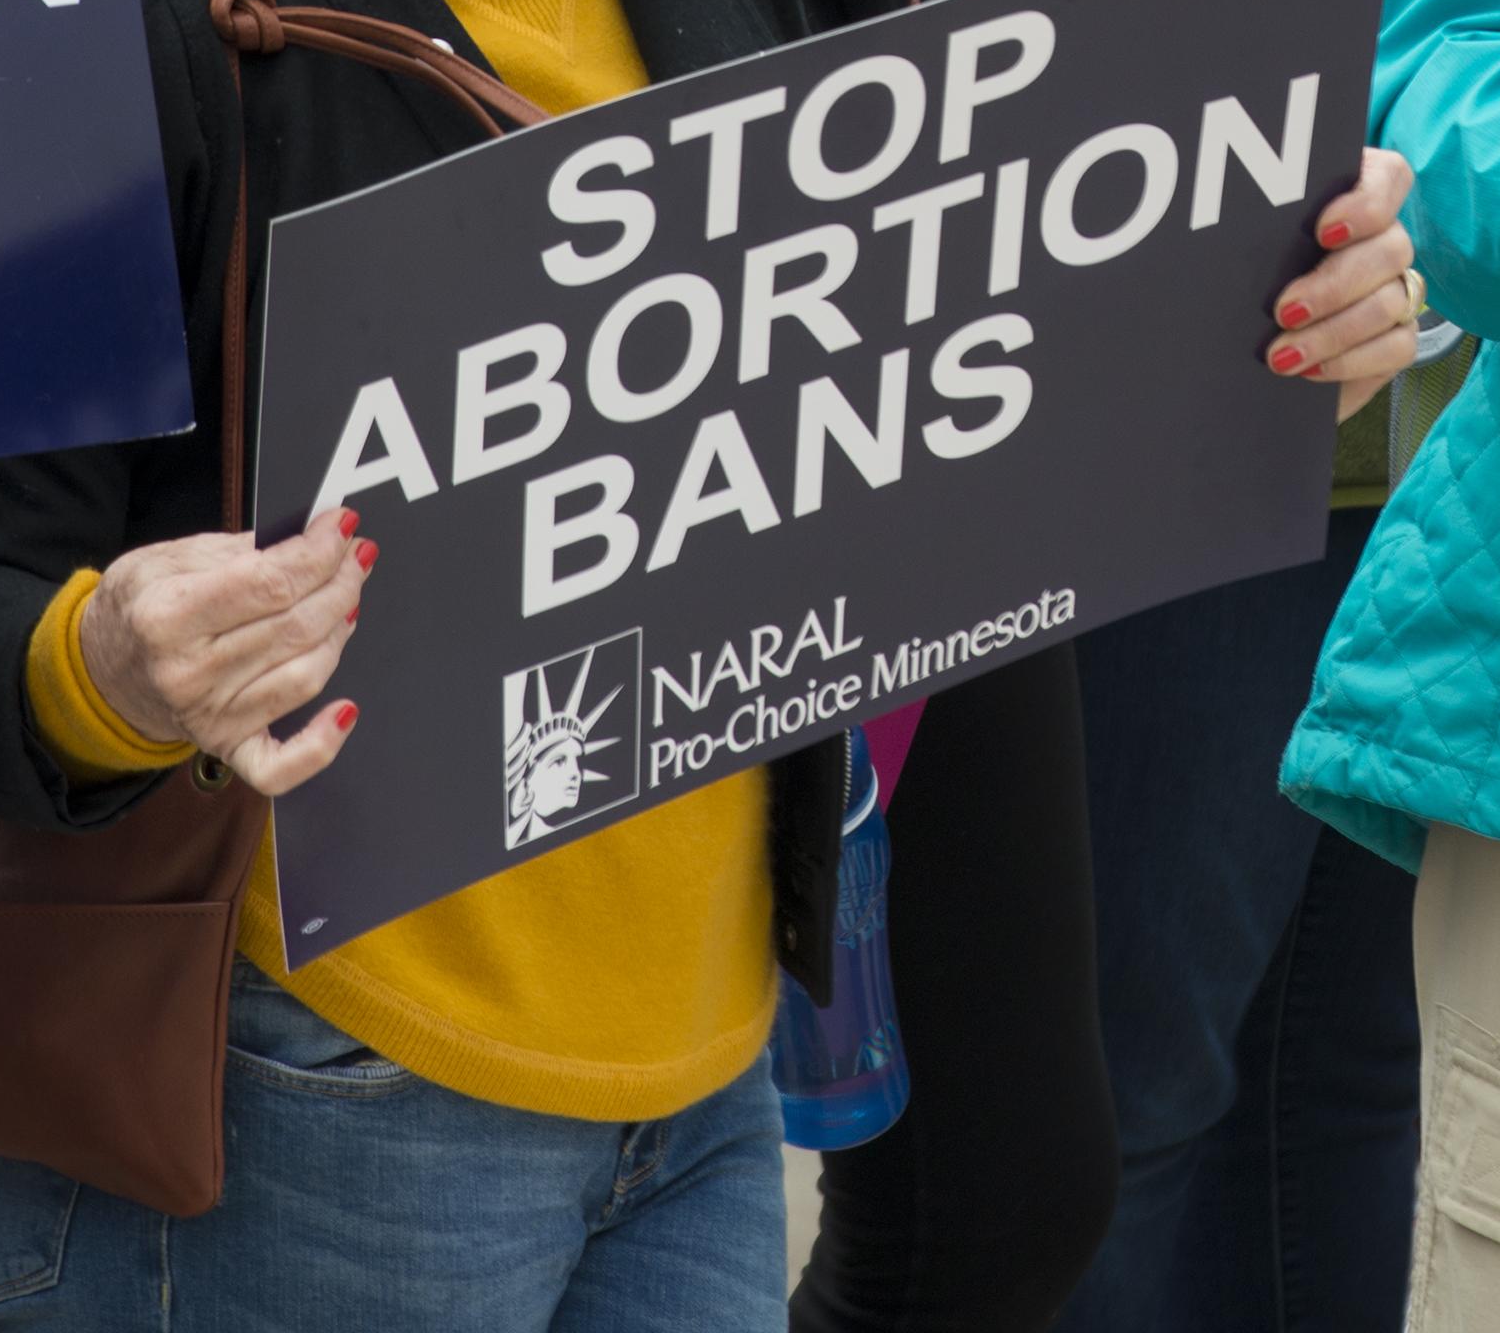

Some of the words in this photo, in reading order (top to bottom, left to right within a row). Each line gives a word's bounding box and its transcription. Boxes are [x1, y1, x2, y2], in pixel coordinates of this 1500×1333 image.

[541, 8, 1058, 288] STOP
[306, 72, 1322, 524] ABORTION
[521, 313, 1035, 619] BANS
[649, 673, 864, 790] Pro-Choice
[869, 584, 1078, 701] Minnesota
[650, 597, 865, 727] NARAL
